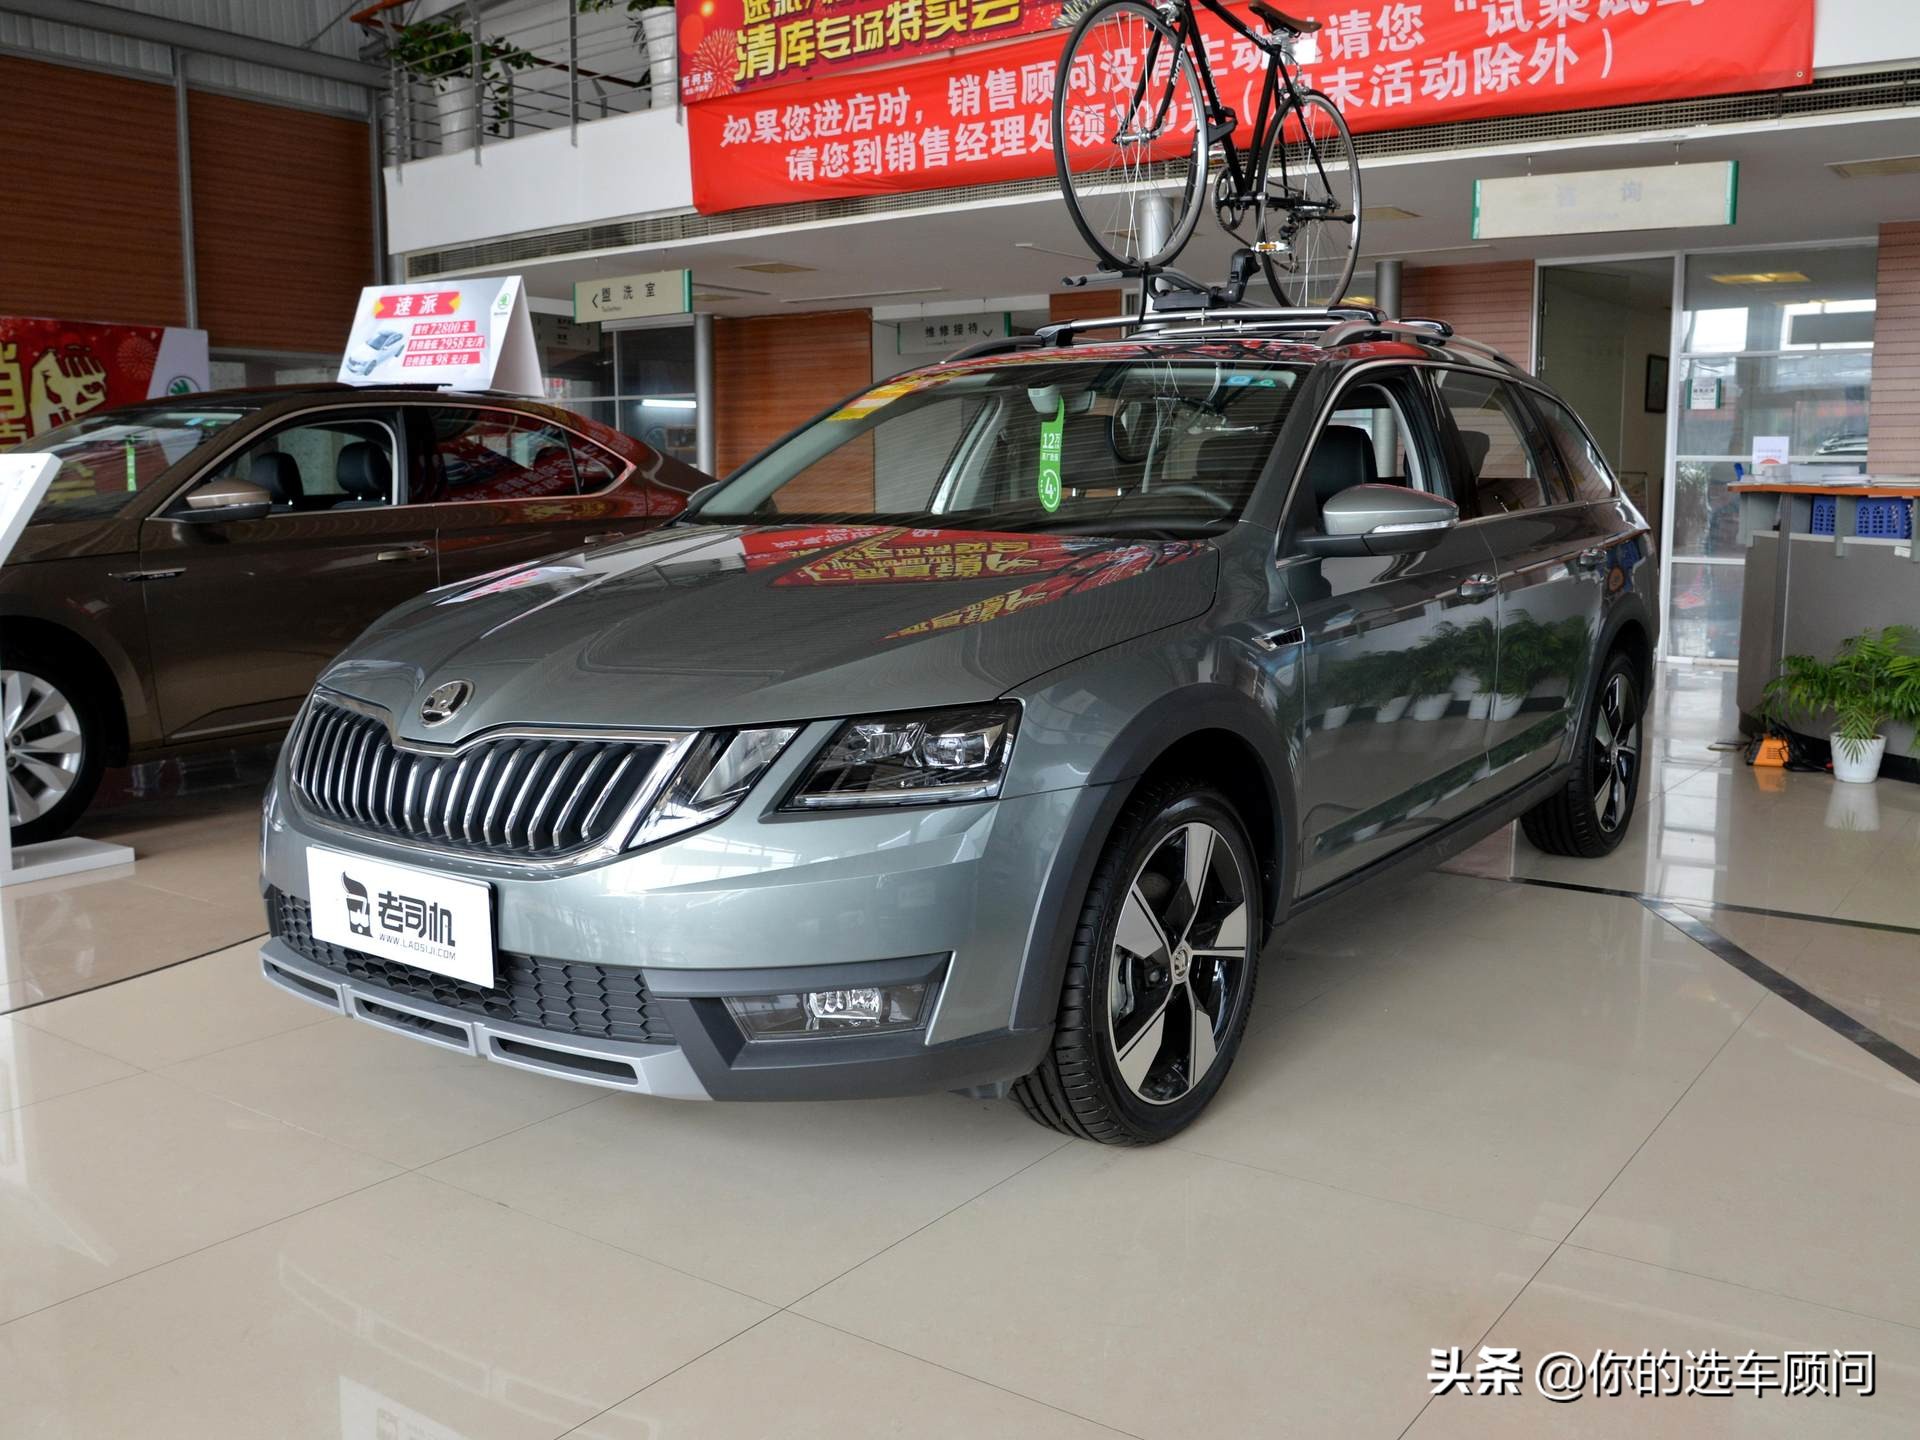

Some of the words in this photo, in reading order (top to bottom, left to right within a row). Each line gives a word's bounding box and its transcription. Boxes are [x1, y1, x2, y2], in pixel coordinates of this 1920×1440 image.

[393, 294, 440, 316] 速派
[378, 890, 455, 947] 老司机
